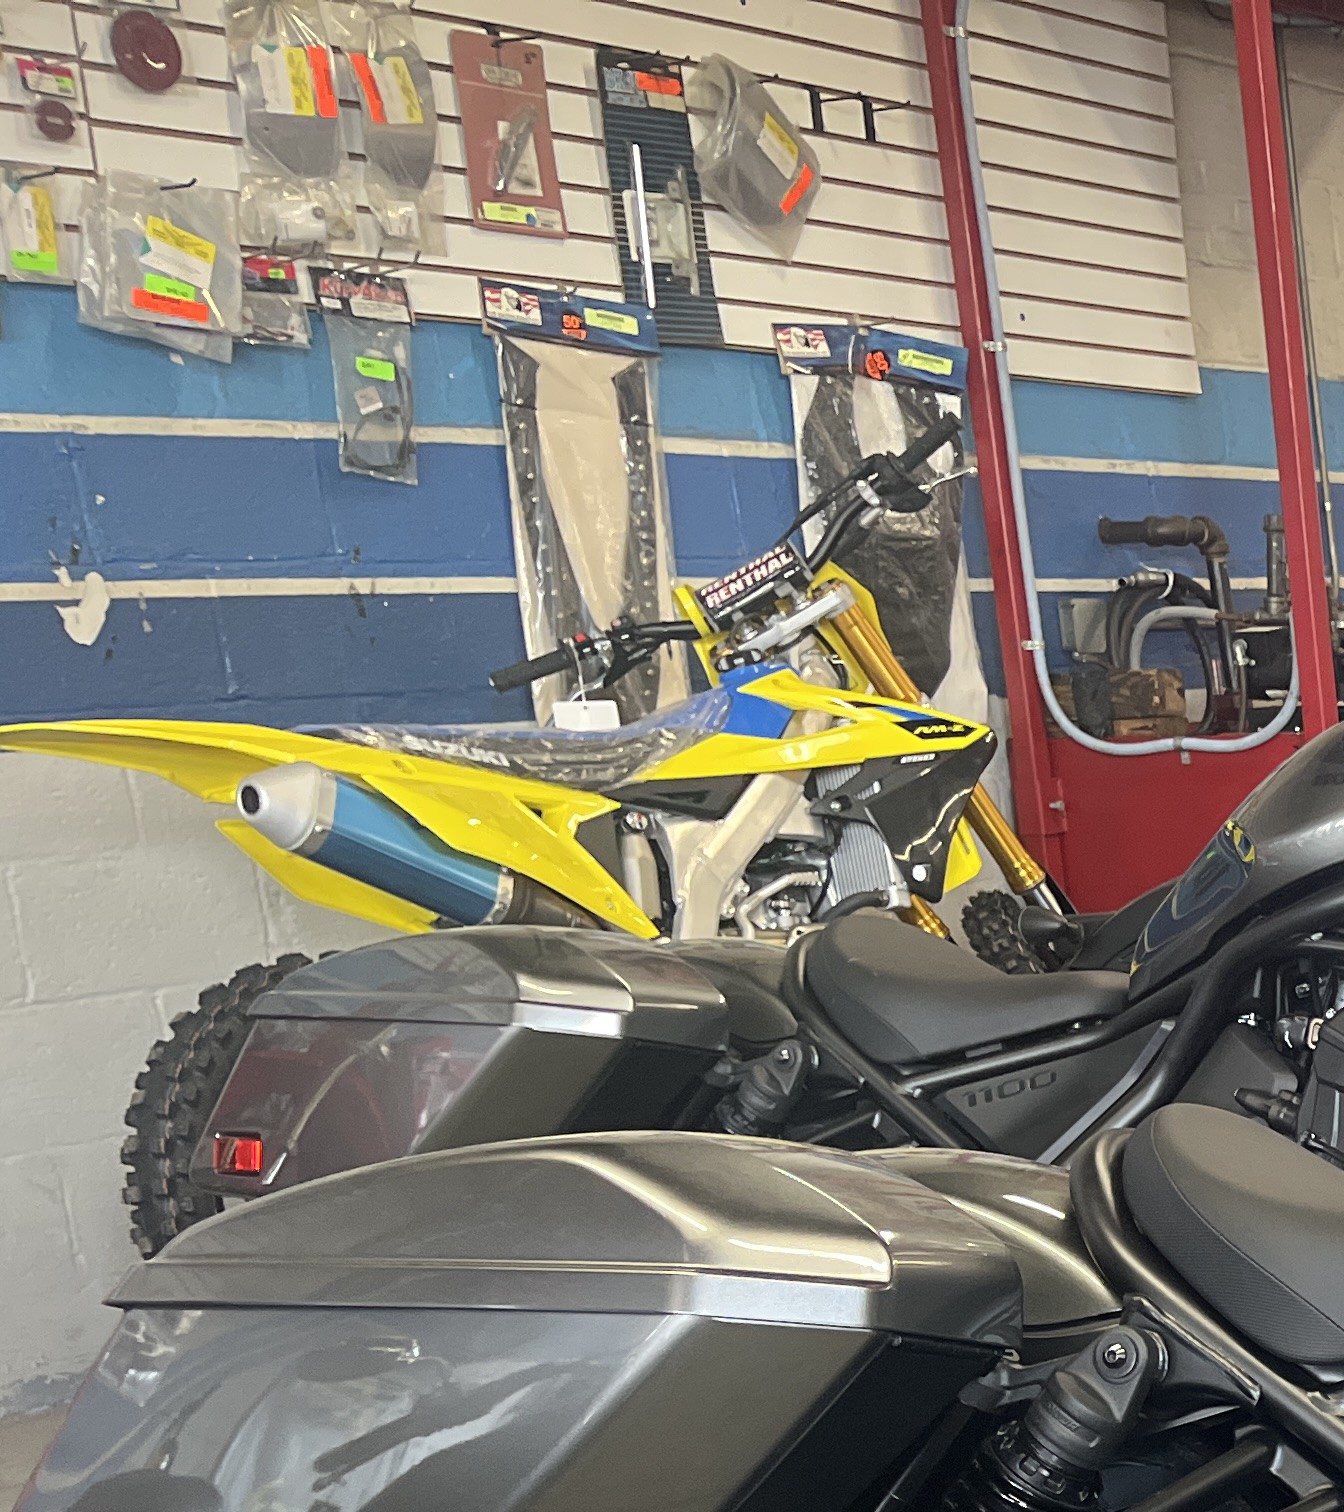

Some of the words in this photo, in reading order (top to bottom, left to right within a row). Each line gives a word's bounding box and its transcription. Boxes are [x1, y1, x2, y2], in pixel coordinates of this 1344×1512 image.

[705, 552, 794, 608] RENTHAL
[401, 734, 511, 768] SUZUKI
[962, 1071, 1057, 1108] 1100
